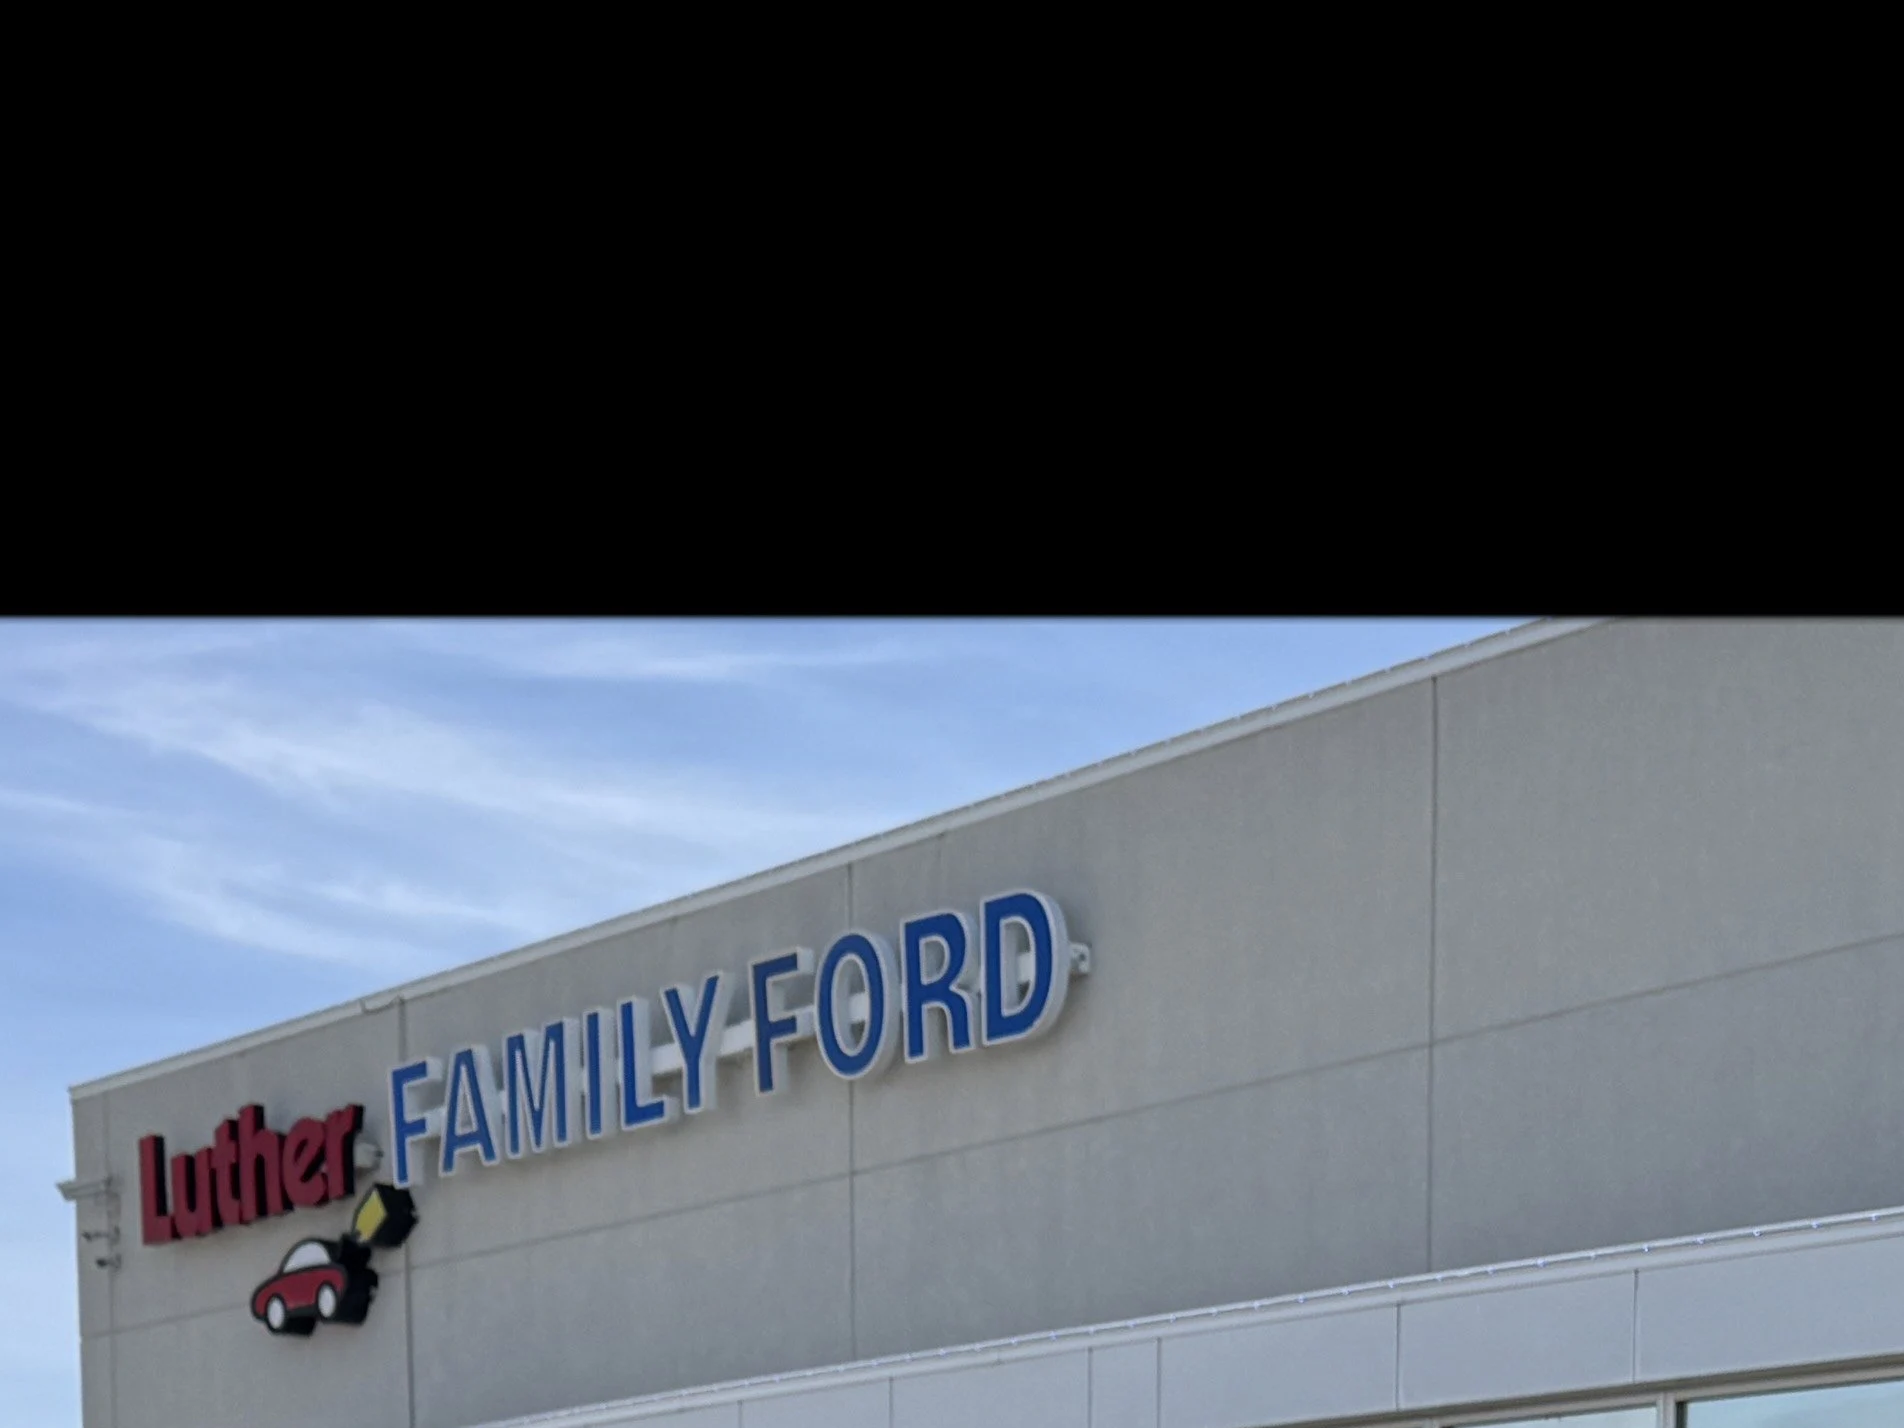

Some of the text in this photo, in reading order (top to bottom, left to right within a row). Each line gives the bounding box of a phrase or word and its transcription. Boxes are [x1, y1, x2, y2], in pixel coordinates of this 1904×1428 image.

[389, 888, 1064, 1189] FAMILY FORD
[139, 1104, 364, 1246] Luther
